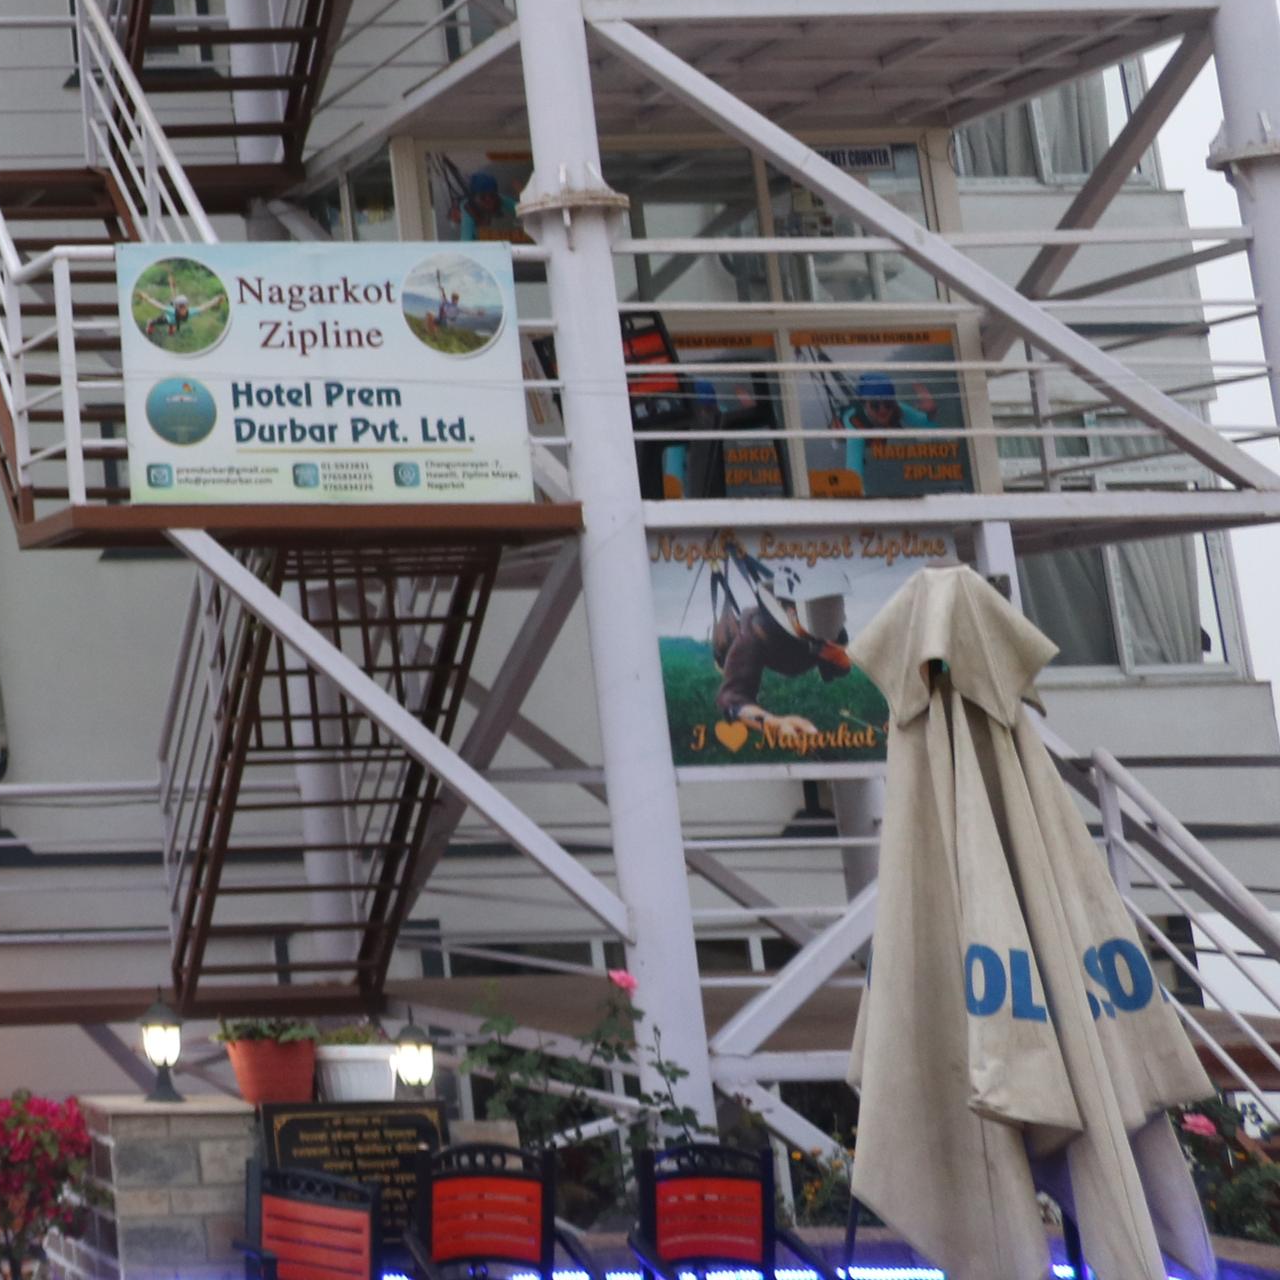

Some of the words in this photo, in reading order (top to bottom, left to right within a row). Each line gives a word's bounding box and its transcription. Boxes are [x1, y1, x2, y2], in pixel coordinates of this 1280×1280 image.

[237, 275, 396, 313] Nagarkot
[259, 320, 384, 357] Zipline
[231, 381, 313, 410] Hotel
[325, 381, 402, 408] Prem
[234, 417, 338, 444] Durbar
[350, 417, 408, 443] Pvt.
[420, 416, 476, 443] Ltd.
[872, 444, 959, 459] NAGARKOT
[903, 464, 965, 481] ZIPLINE
[858, 527, 948, 566] Zipline
[755, 722, 879, 755] Nagarkot
